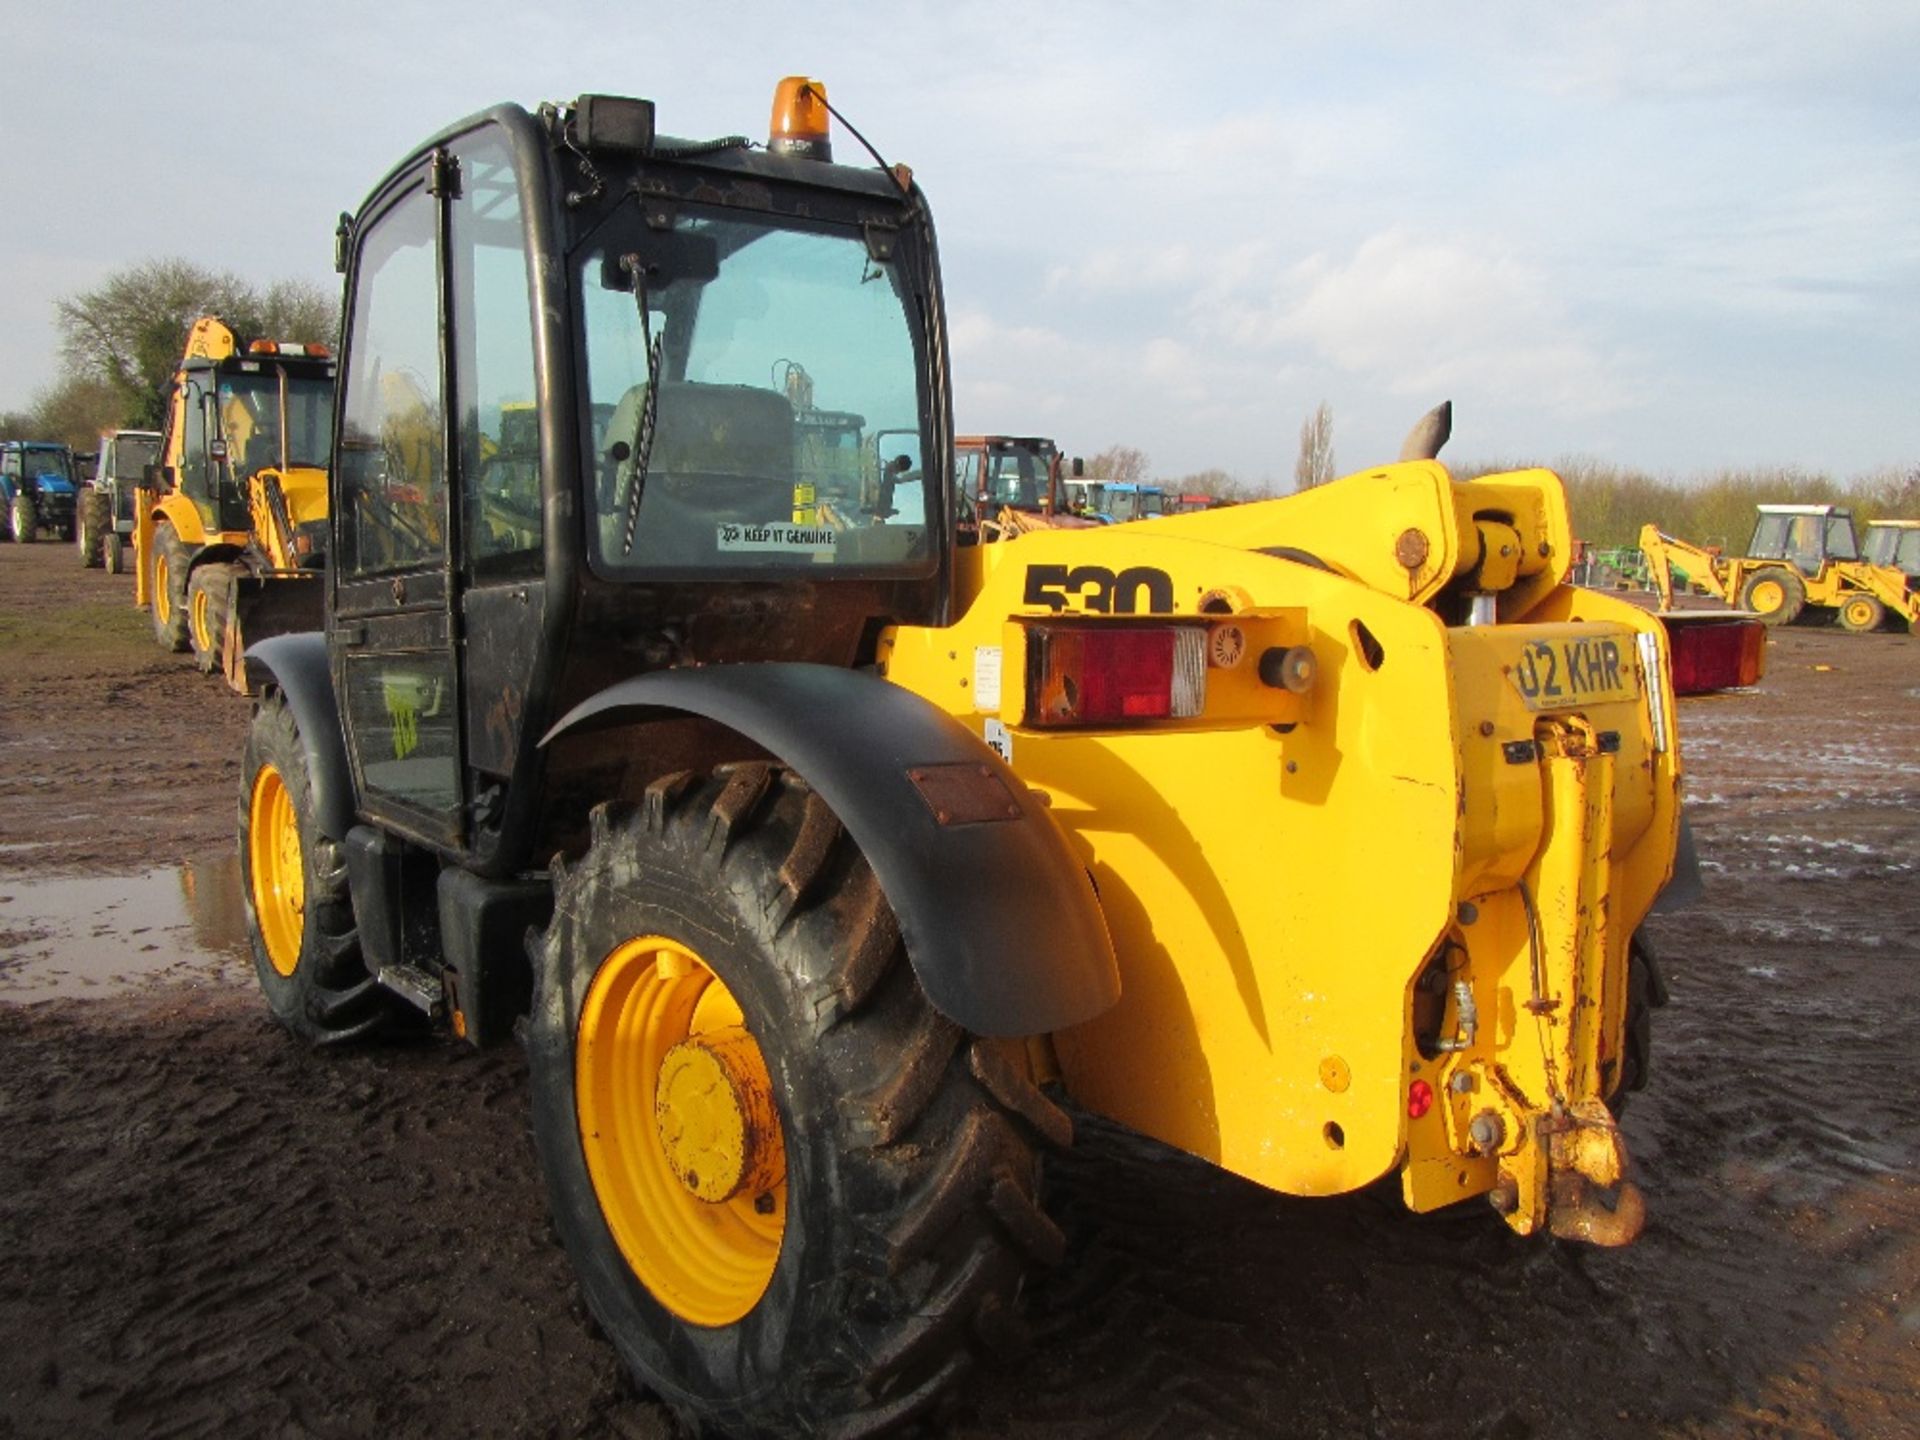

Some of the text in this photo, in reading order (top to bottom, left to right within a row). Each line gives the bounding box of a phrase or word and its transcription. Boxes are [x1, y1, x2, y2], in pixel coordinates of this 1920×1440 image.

[744, 527, 770, 542] KEEP
[772, 528, 783, 543] IT
[1023, 564, 1174, 615] 530
[1563, 640, 1623, 694] KHR
